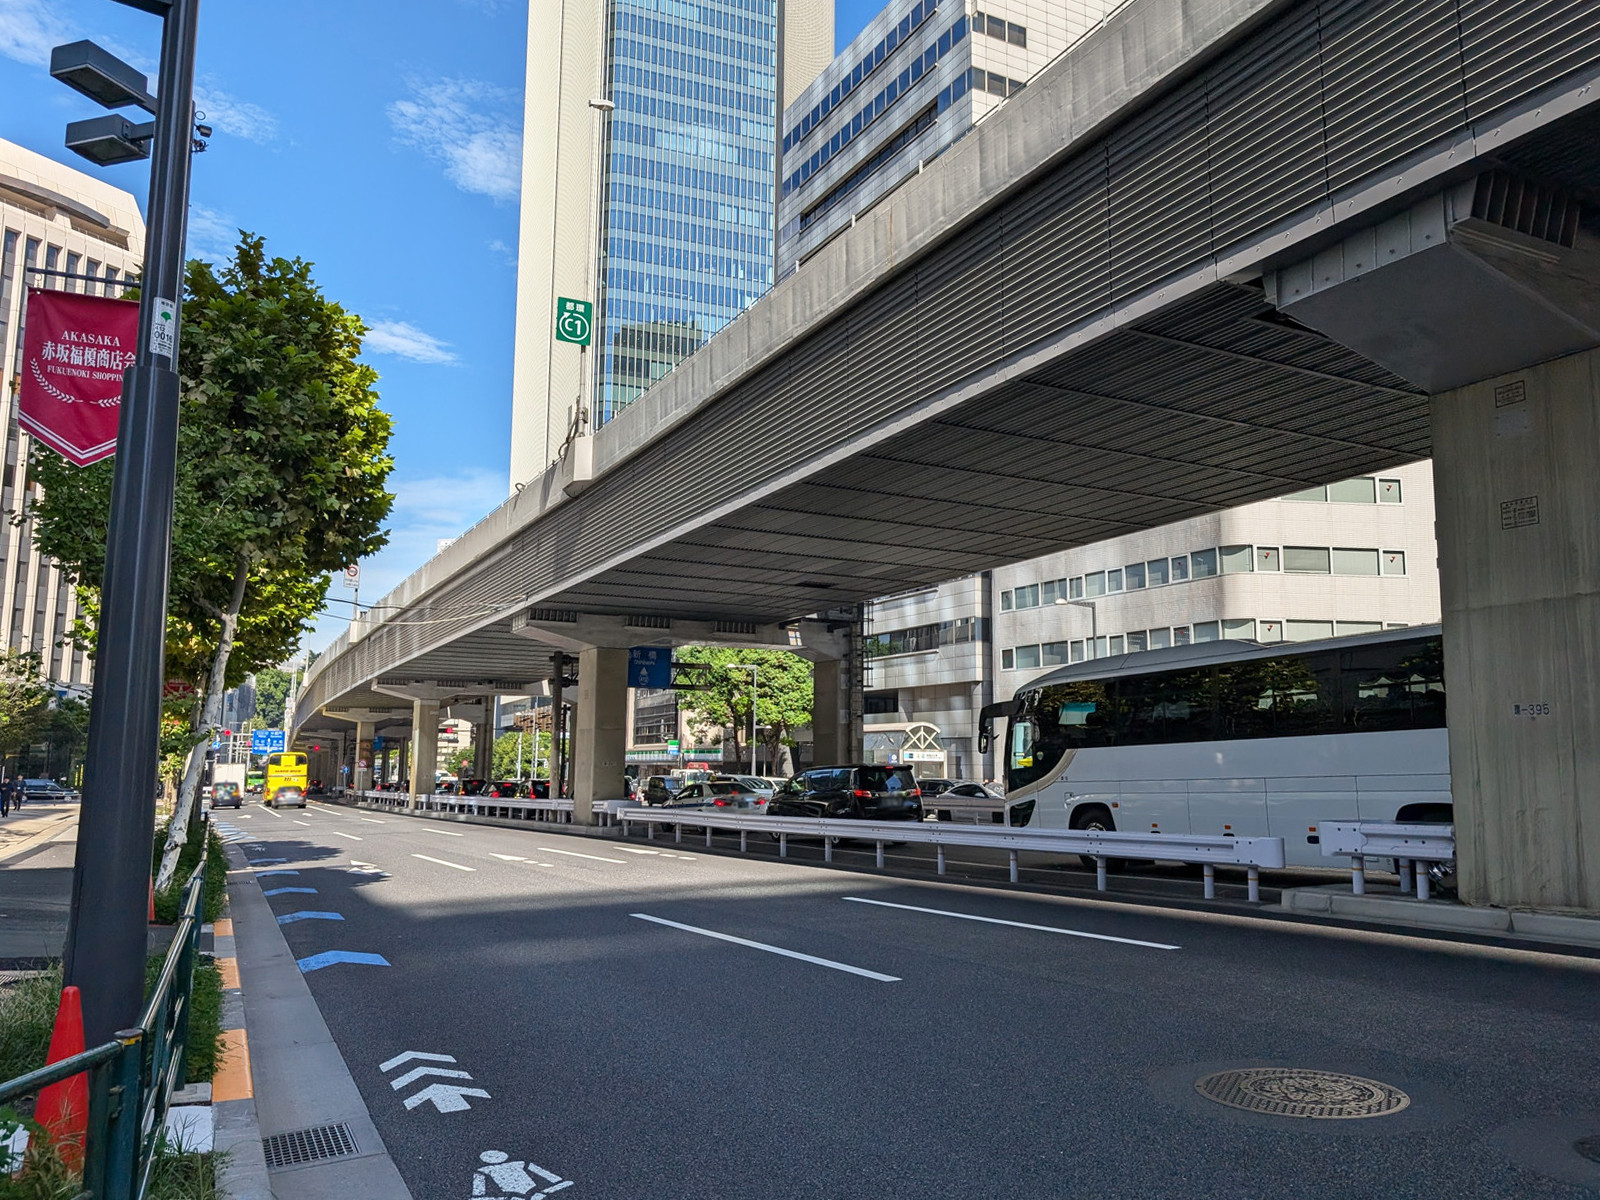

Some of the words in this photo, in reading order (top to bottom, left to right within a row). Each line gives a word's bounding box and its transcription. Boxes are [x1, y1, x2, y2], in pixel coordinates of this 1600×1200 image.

[565, 318, 581, 336] C1
[61, 330, 121, 347] AKASAKA
[42, 340, 136, 371] 赤坂福榎商店会
[47, 364, 90, 379] FUKUENOKI
